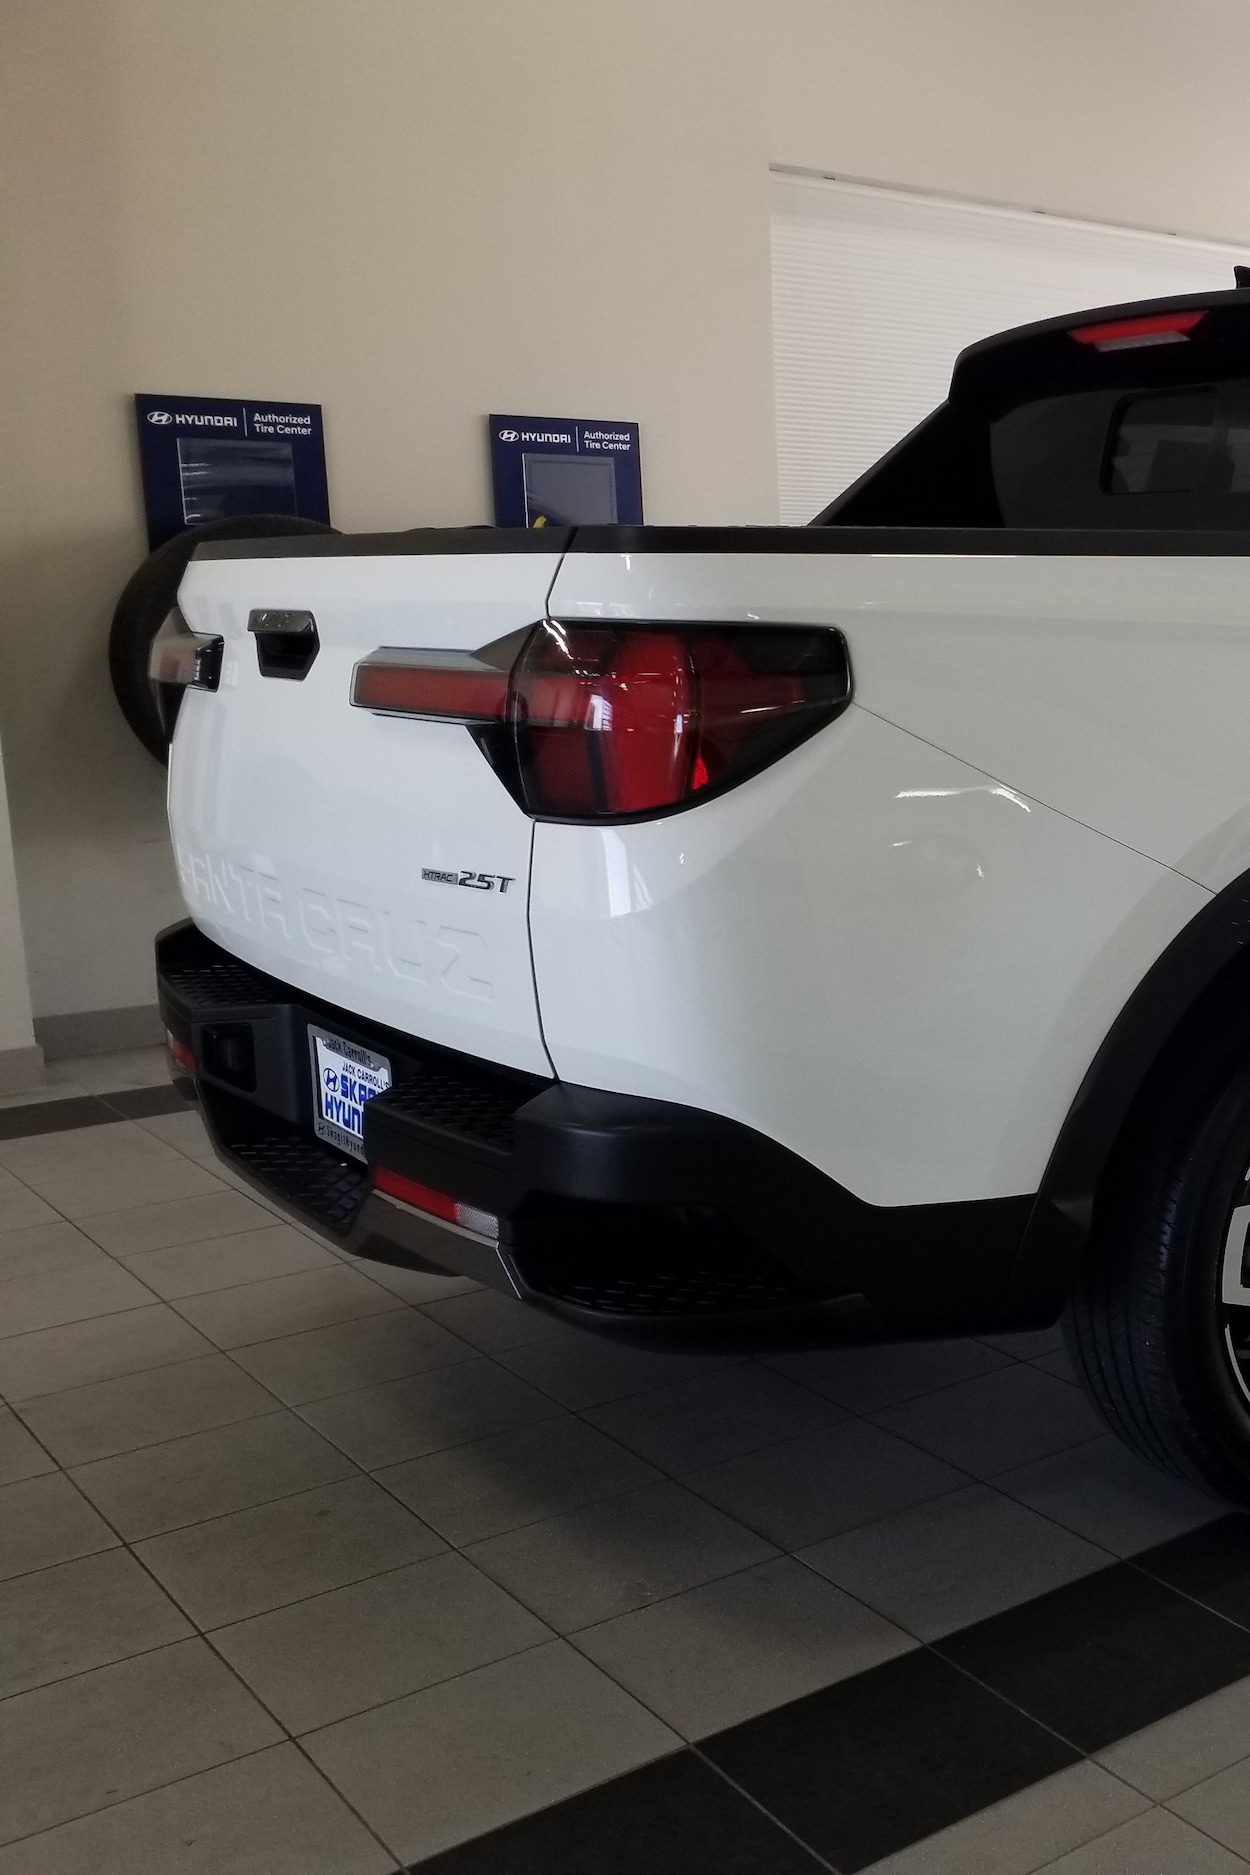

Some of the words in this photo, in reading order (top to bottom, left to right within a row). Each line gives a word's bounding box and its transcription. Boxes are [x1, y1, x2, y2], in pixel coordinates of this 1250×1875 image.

[175, 413, 238, 428] HYUNDAI
[253, 412, 312, 425] Authorized
[254, 424, 275, 434] Tire
[276, 424, 312, 436] Center
[583, 430, 631, 441] Authorized
[521, 432, 572, 444] HYUNDAI
[584, 440, 601, 449] Tire
[601, 441, 631, 451] Center
[423, 870, 454, 883] HTRAC
[299, 887, 495, 1001] CRUZ
[341, 1061, 357, 1078] JACK
[357, 1068, 390, 1090] CARROLL'S
[325, 1091, 364, 1136] HYUN
